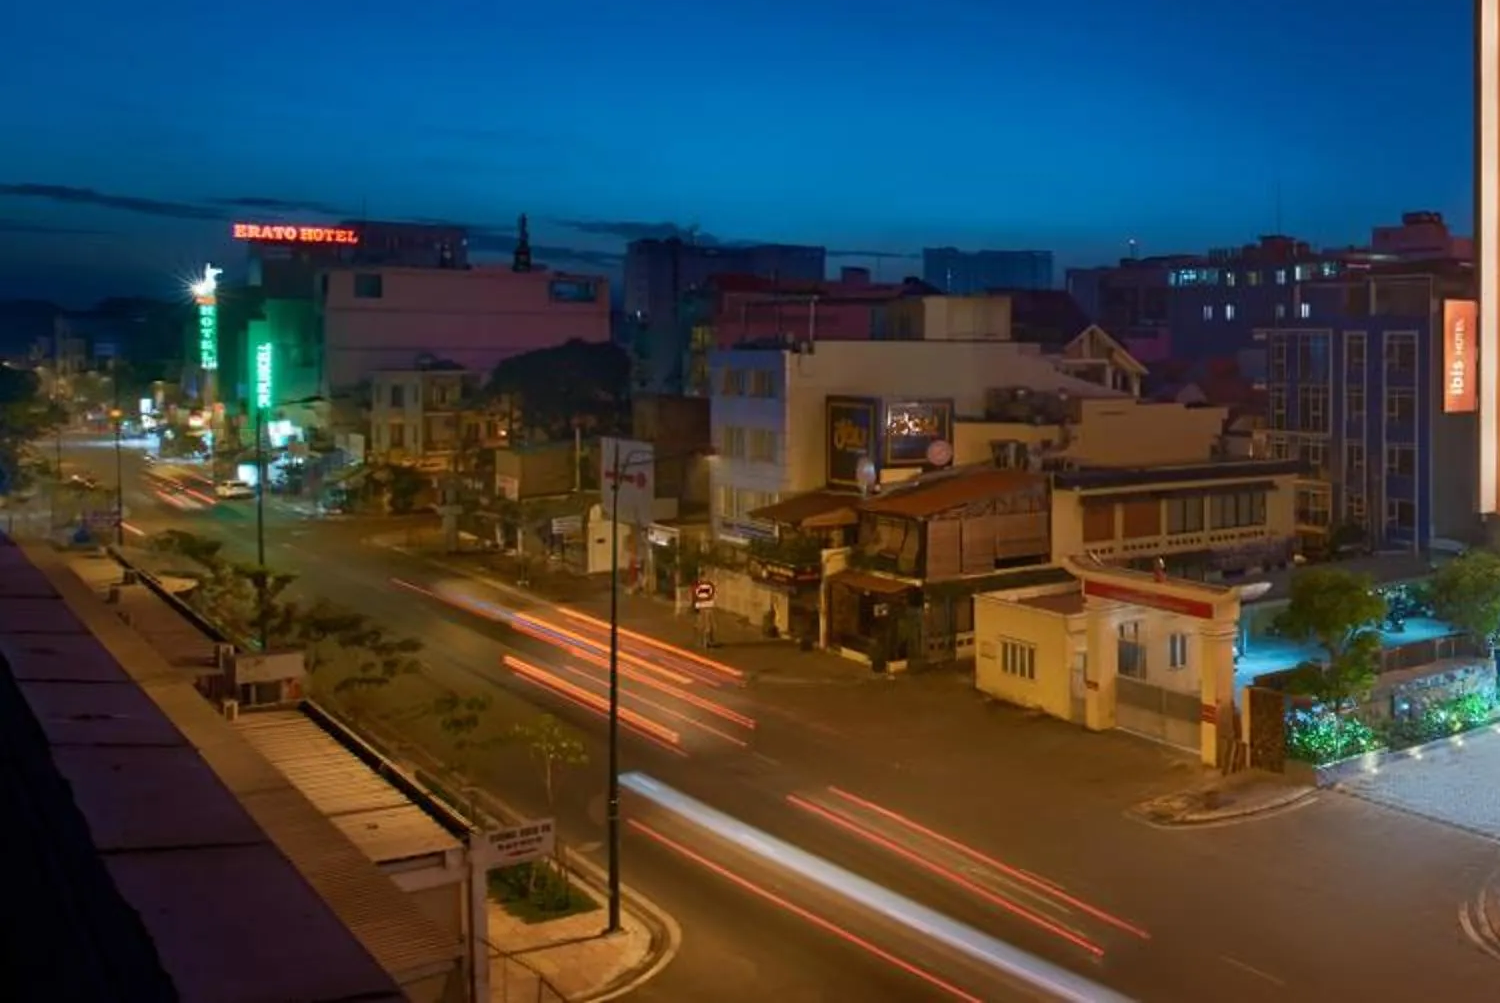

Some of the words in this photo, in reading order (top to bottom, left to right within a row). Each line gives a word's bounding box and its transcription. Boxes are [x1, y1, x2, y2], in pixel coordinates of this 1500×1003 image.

[233, 224, 297, 239] ERATO
[299, 228, 358, 243] HOTEL
[1451, 360, 1465, 395] ibis
